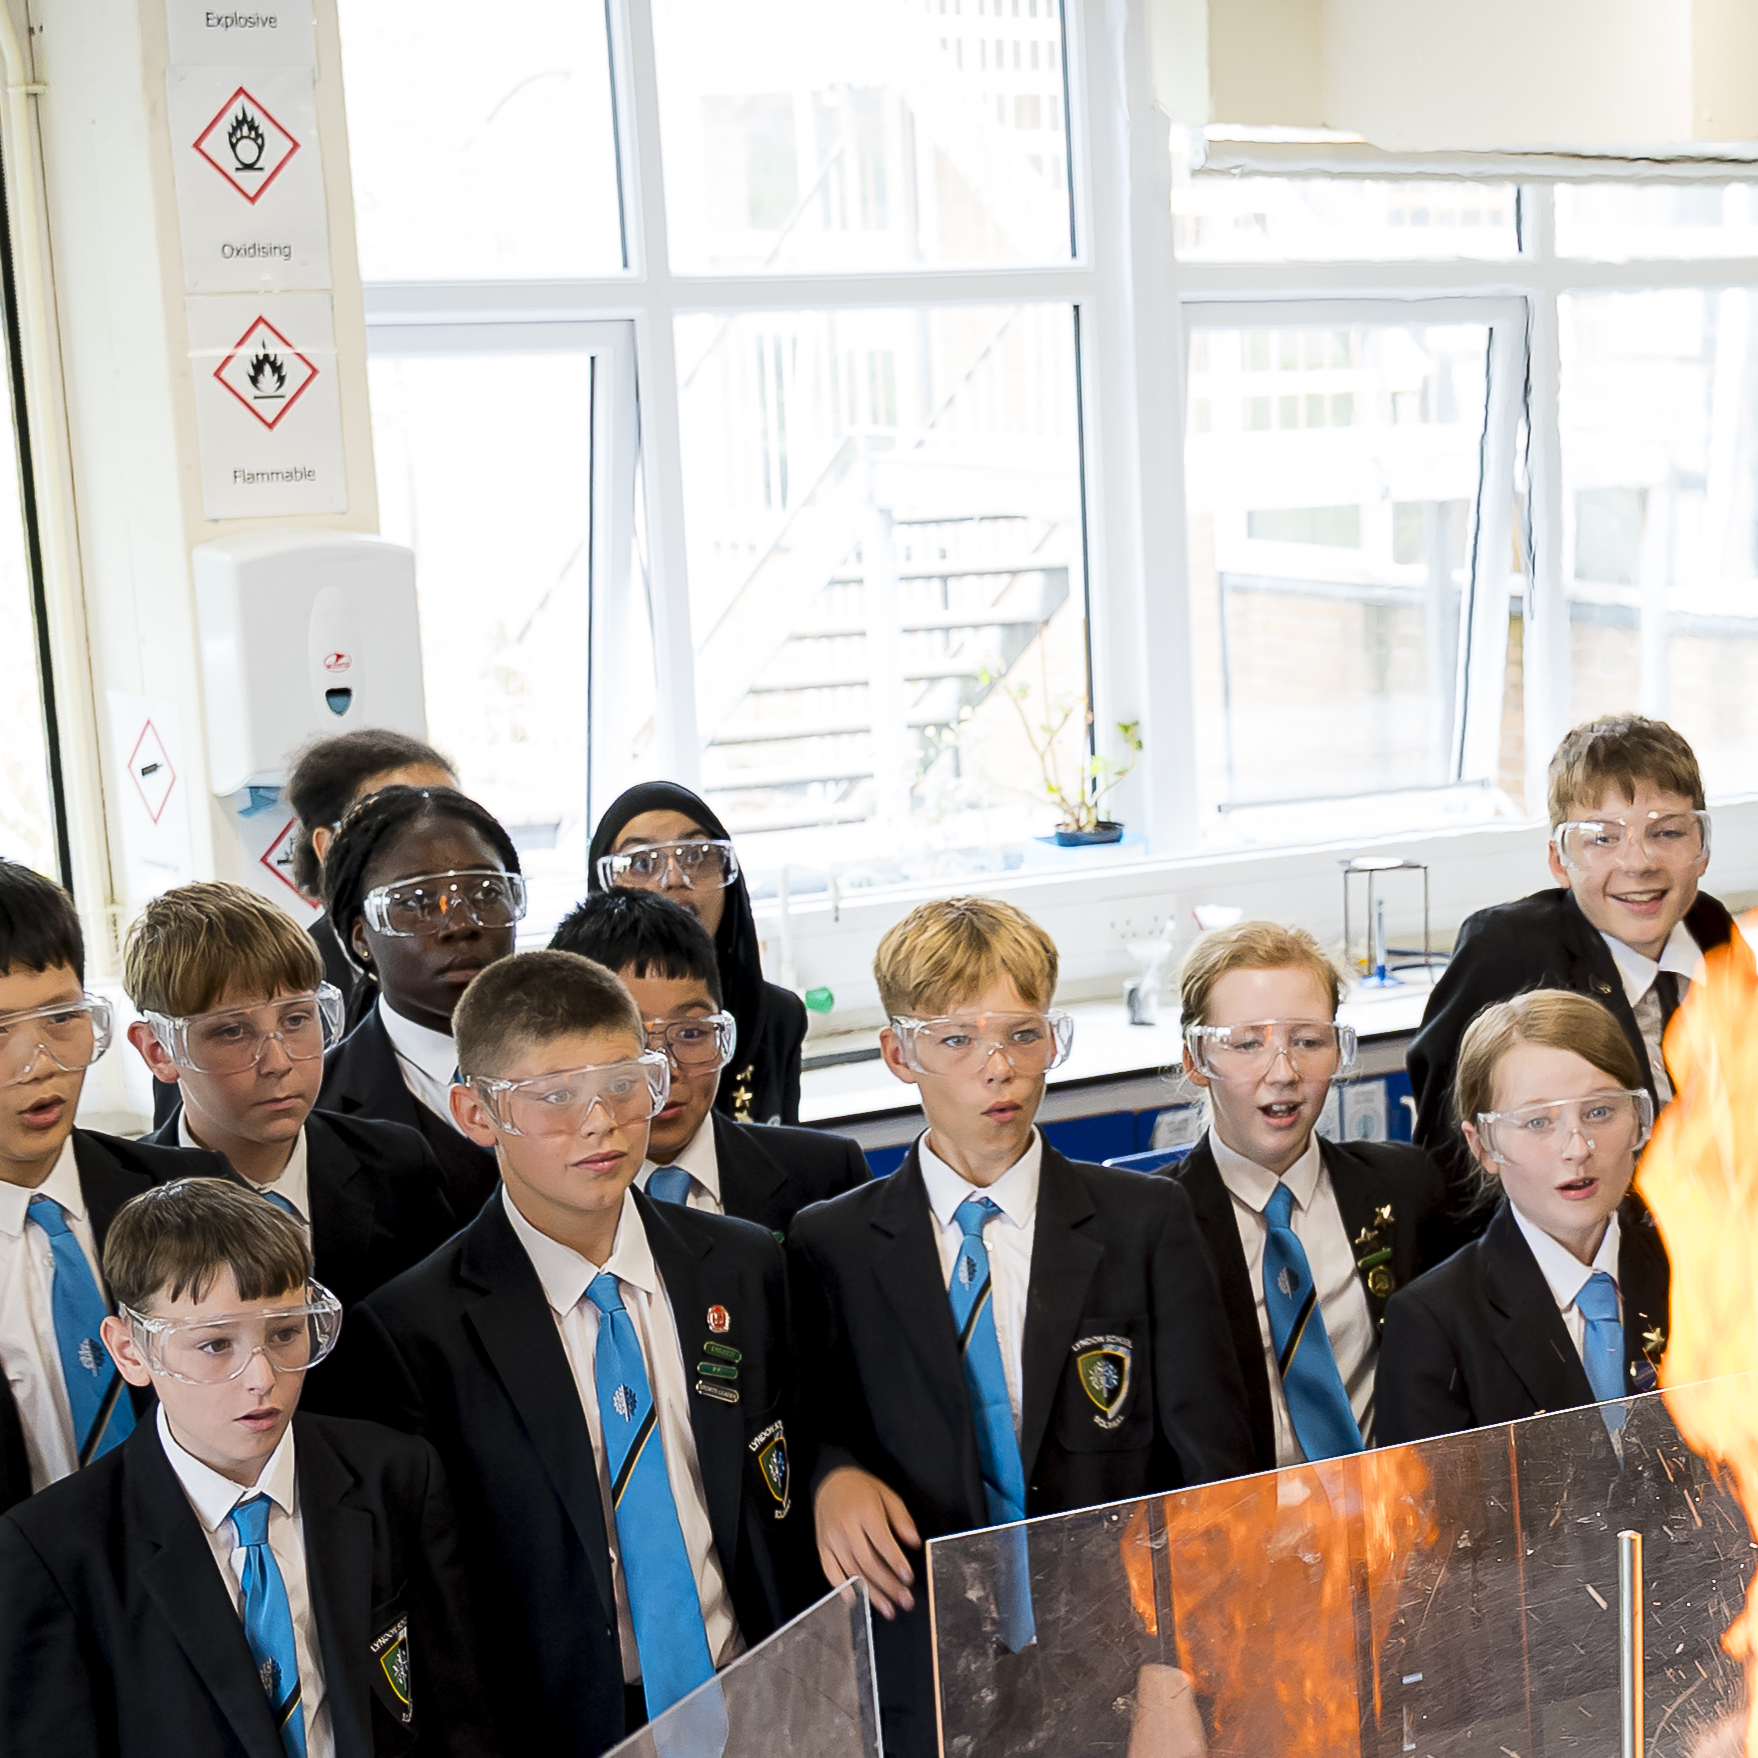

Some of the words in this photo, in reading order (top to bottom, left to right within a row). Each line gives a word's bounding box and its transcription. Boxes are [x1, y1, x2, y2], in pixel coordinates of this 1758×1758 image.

[205, 11, 278, 31] Explosive
[221, 243, 292, 261] Oxidising
[232, 466, 316, 484] Flammable
